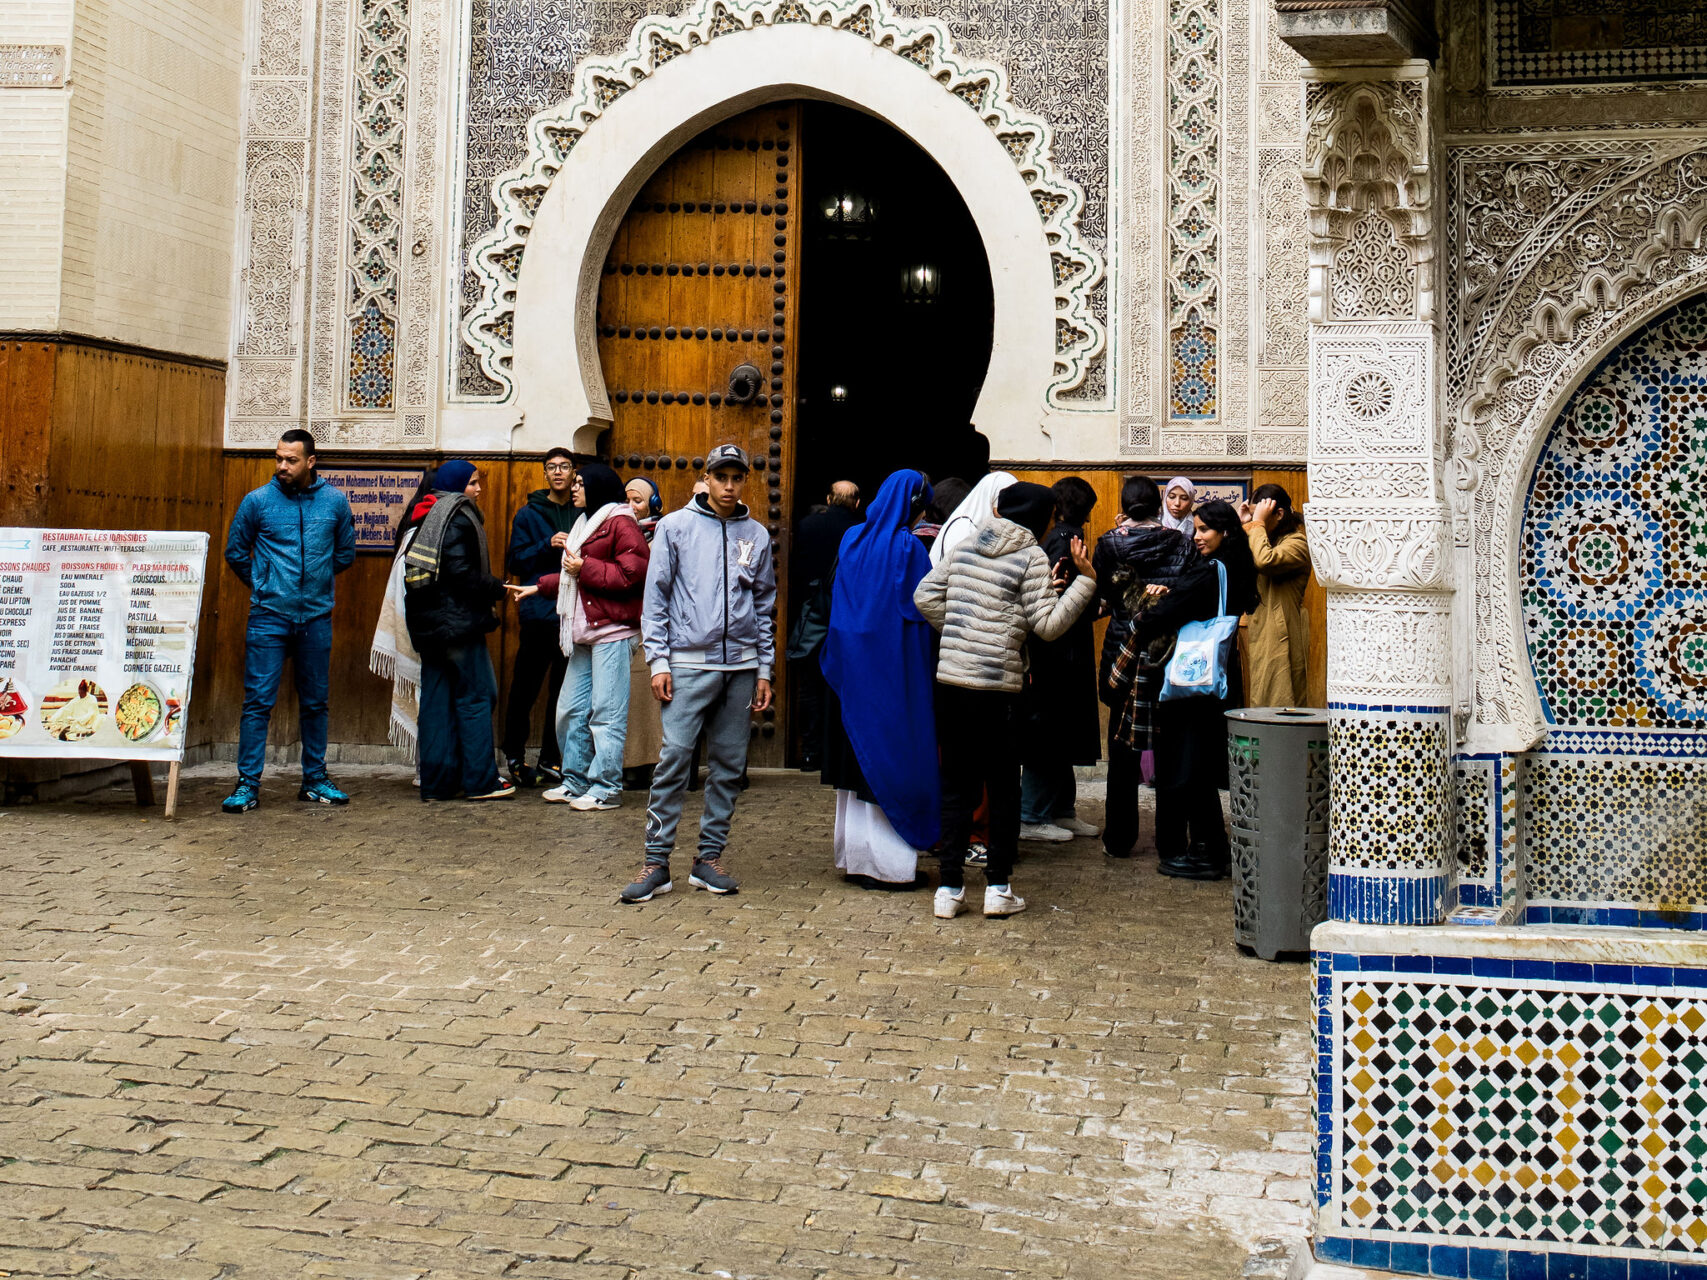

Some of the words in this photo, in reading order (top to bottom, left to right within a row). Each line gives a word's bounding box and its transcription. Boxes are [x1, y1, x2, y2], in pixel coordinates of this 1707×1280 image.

[318, 475, 344, 486] dation
[346, 475, 378, 488] Mohammed
[379, 476, 395, 487] Karim
[397, 476, 420, 488] Lamrani
[379, 492, 403, 507] Nejjarine
[364, 512, 389, 528] Nejjarine
[384, 528, 390, 540] du
[22, 563, 50, 571] CHAUDES
[152, 564, 189, 572] MAROCAINS
[124, 664, 144, 672] CORNE
